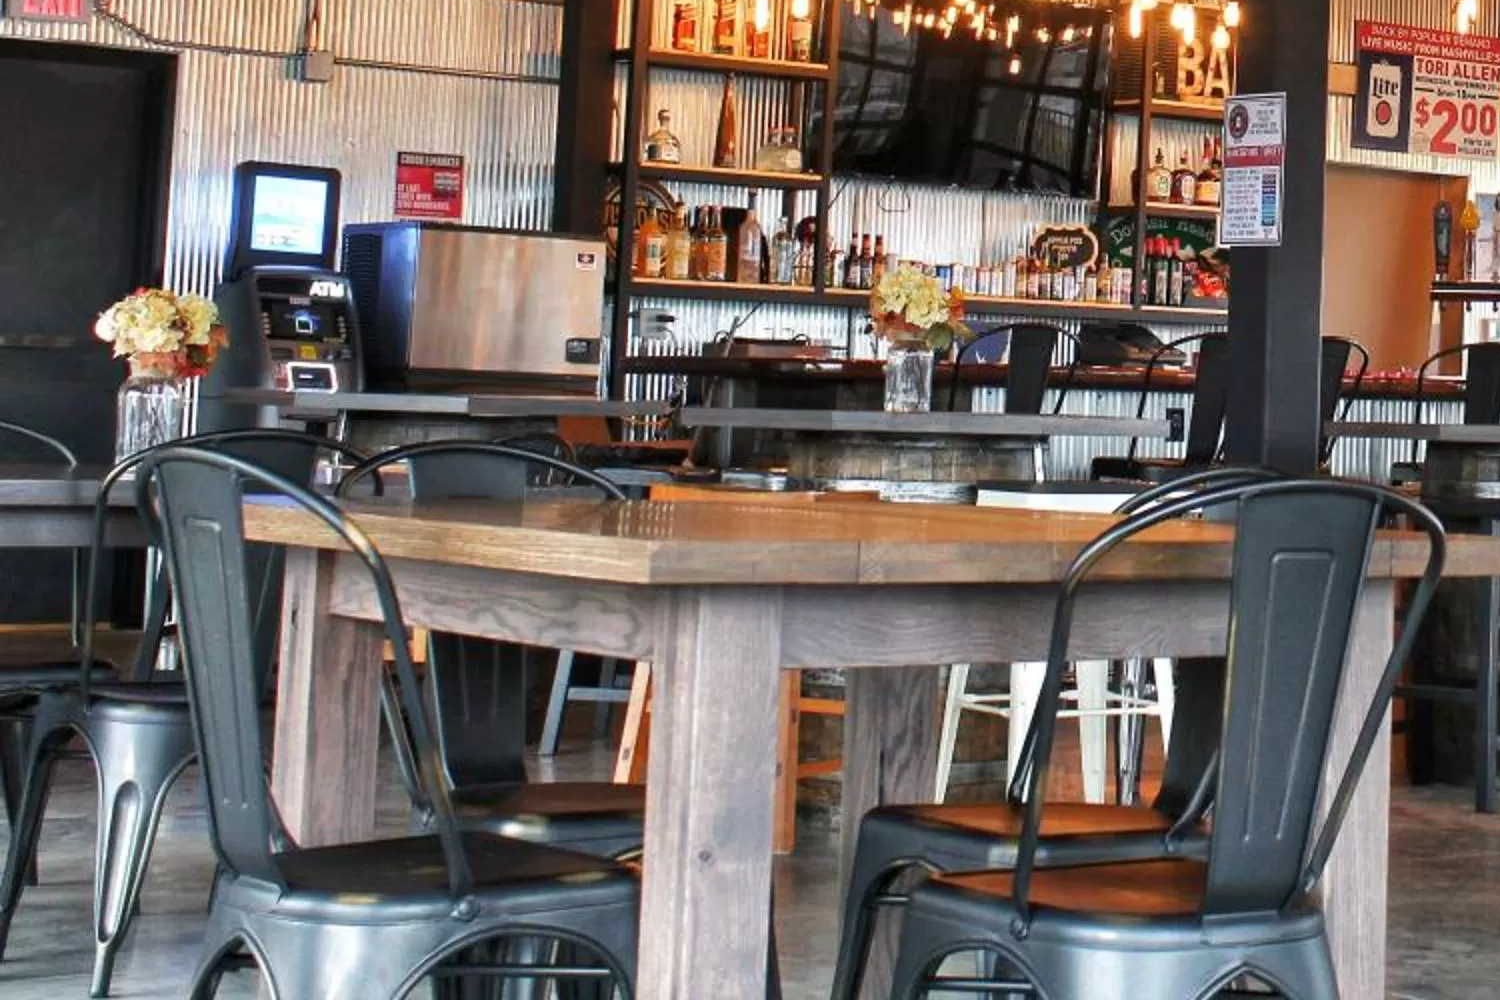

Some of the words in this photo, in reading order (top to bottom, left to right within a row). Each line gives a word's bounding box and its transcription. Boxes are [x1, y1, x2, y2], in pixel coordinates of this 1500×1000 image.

[1361, 35, 1382, 48] LIVE
[1383, 38, 1412, 52] MUSIC
[1414, 43, 1440, 56] FROM
[1371, 24, 1397, 36] BACK
[1398, 28, 1409, 38] BY
[1411, 30, 1451, 44] POPULAR
[1453, 35, 1491, 48] DEMAND
[1415, 58, 1449, 77] TORI
[1453, 63, 1500, 82] ALLEN
[1373, 77, 1399, 99] Lite
[309, 282, 345, 297] ATM
